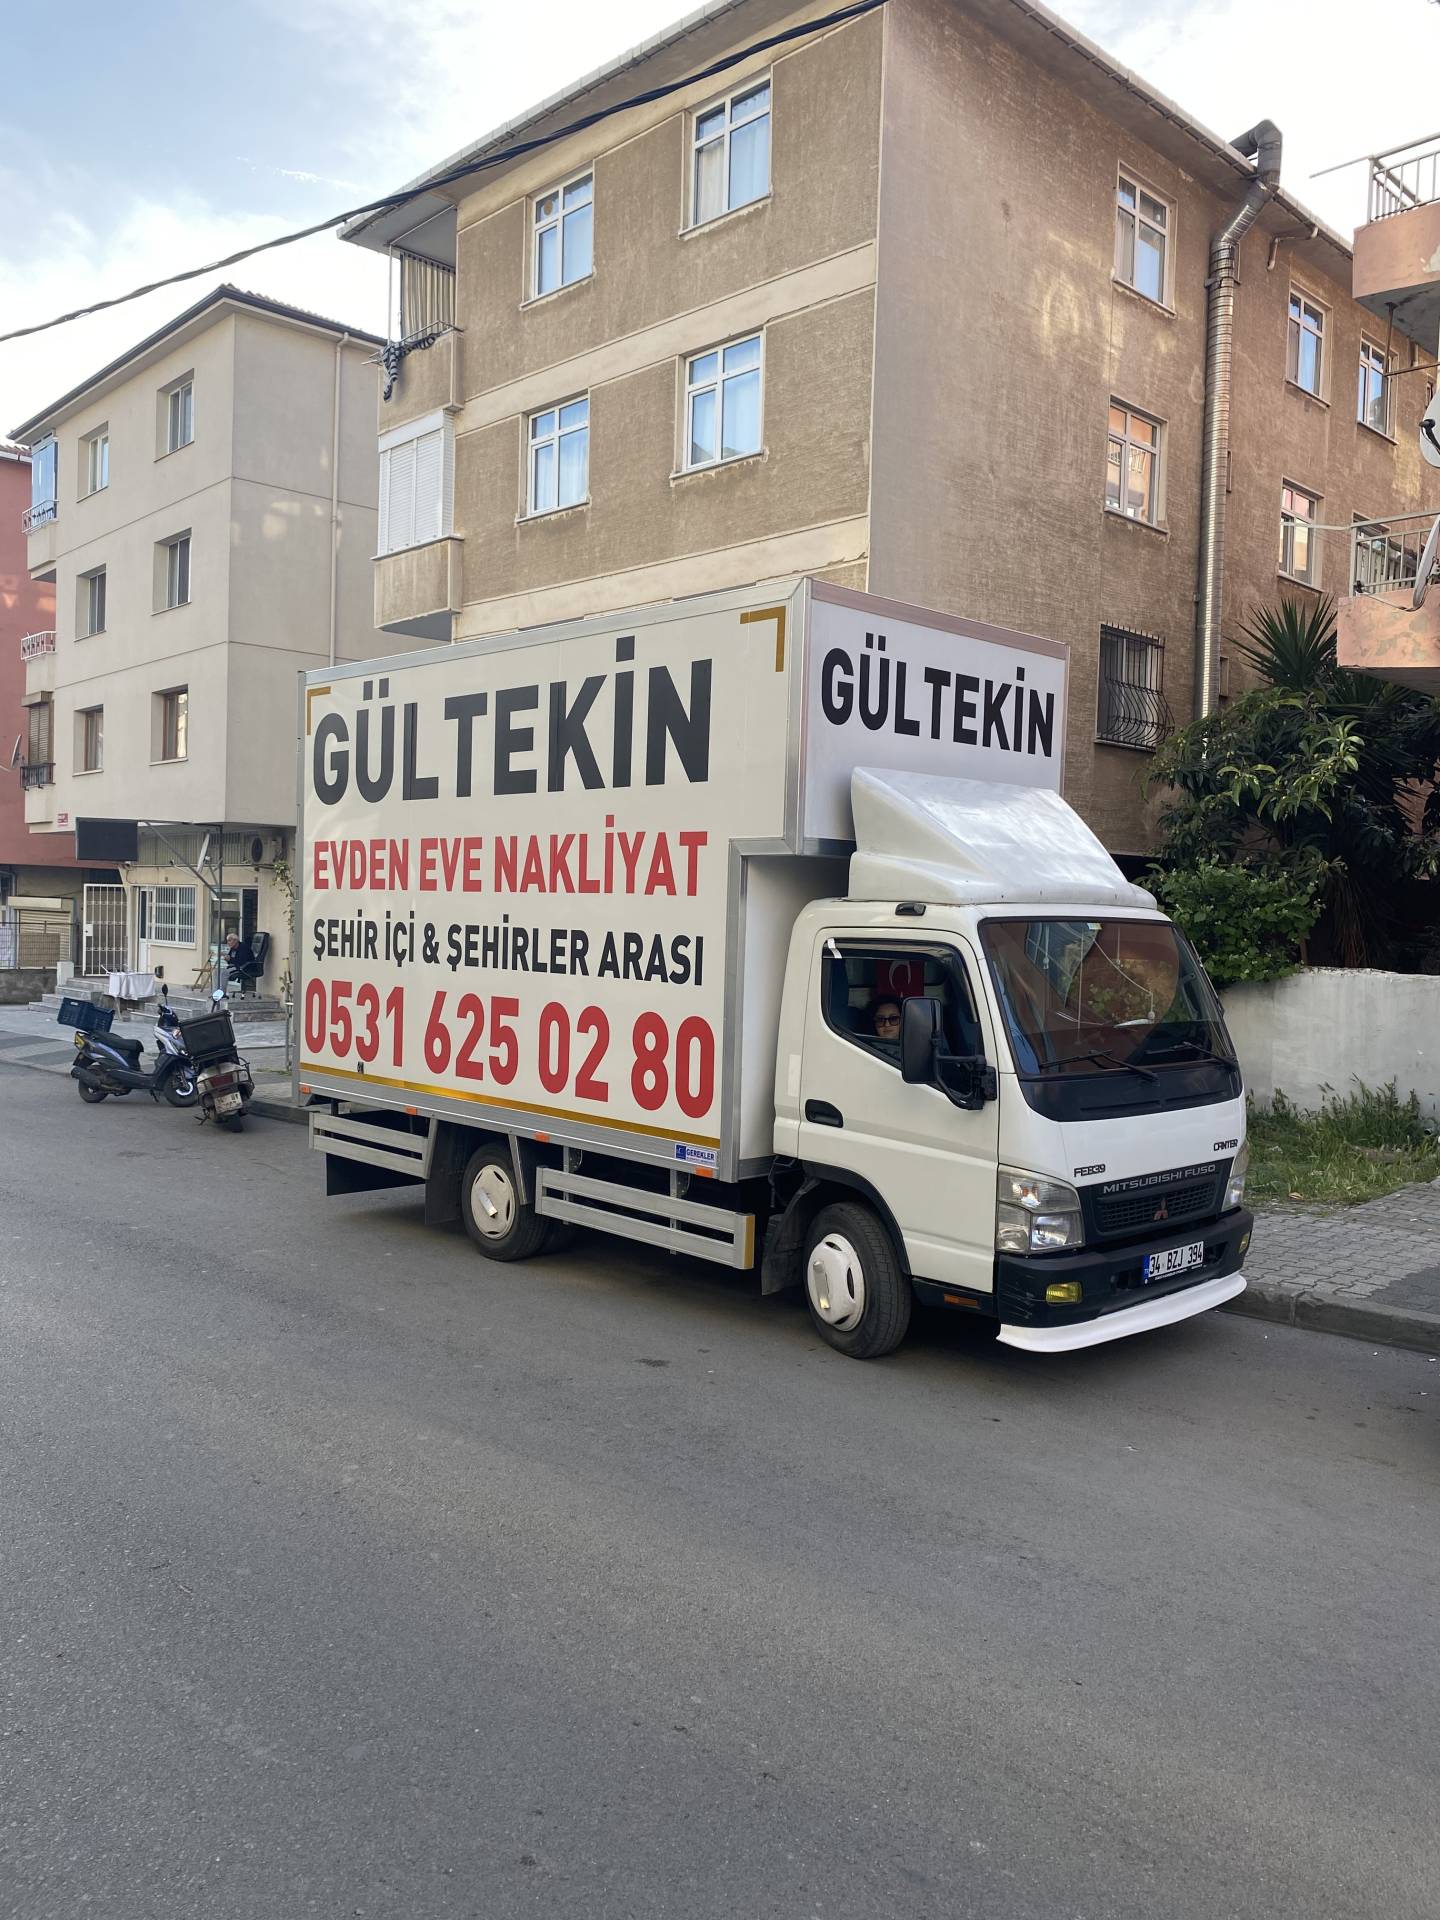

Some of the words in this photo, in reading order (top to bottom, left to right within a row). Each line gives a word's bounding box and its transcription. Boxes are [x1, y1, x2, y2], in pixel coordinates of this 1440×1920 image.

[313, 636, 712, 805] GÜLTEKİN
[821, 632, 1054, 757] GÜLTEKİN
[313, 838, 409, 891] EVDEN
[420, 837, 481, 892] EVE
[494, 815, 708, 896] NAKLİYAT
[313, 909, 377, 961] ŞEHİR
[385, 910, 415, 967] İÇİ
[422, 922, 440, 964] &
[447, 914, 589, 976] ŞEHİRLER
[597, 931, 703, 986] ARASI
[305, 978, 404, 1067] 0531
[424, 991, 519, 1086] 625
[538, 1001, 610, 1102] 02
[631, 1011, 715, 1118] 80
[686, 1148, 715, 1160] GEREKLER
[1103, 1171, 1182, 1194] MITSUBISHI
[1184, 1164, 1216, 1178] FUSO
[1213, 1139, 1238, 1151] CANTER
[1150, 1255, 1160, 1274] 34
[1167, 1249, 1183, 1270] BZJ
[1188, 1243, 1202, 1264] 394
